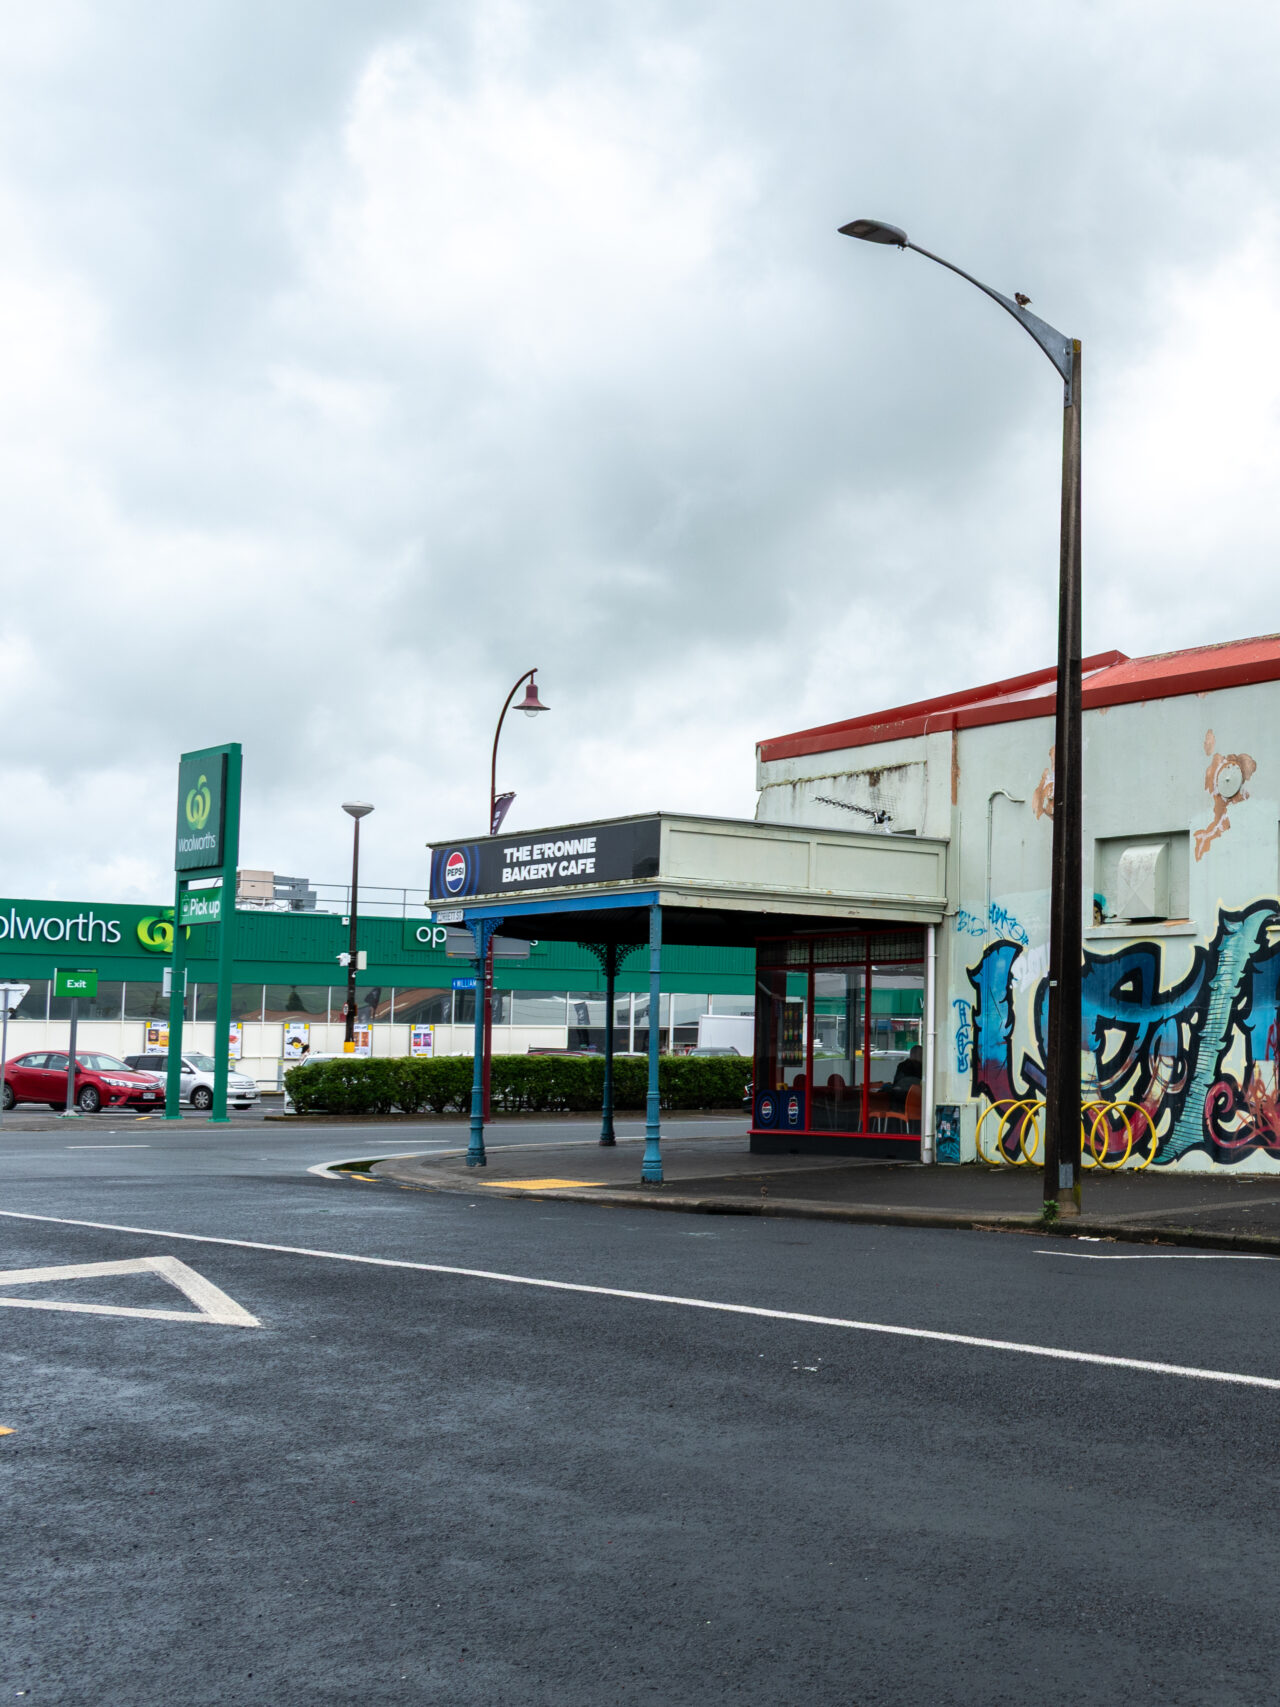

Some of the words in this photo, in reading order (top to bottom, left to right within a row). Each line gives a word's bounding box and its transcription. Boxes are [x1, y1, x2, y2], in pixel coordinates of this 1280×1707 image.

[503, 845, 532, 863] THE
[532, 837, 597, 860] E'RONNIE
[447, 866, 464, 877] PEPSI
[502, 862, 556, 883] BAKERY
[558, 857, 596, 877] CAFE
[190, 897, 208, 916] Pick
[208, 899, 221, 918] up
[0, 907, 122, 943] lworths
[416, 926, 448, 948] op
[66, 979, 87, 989] Exit
